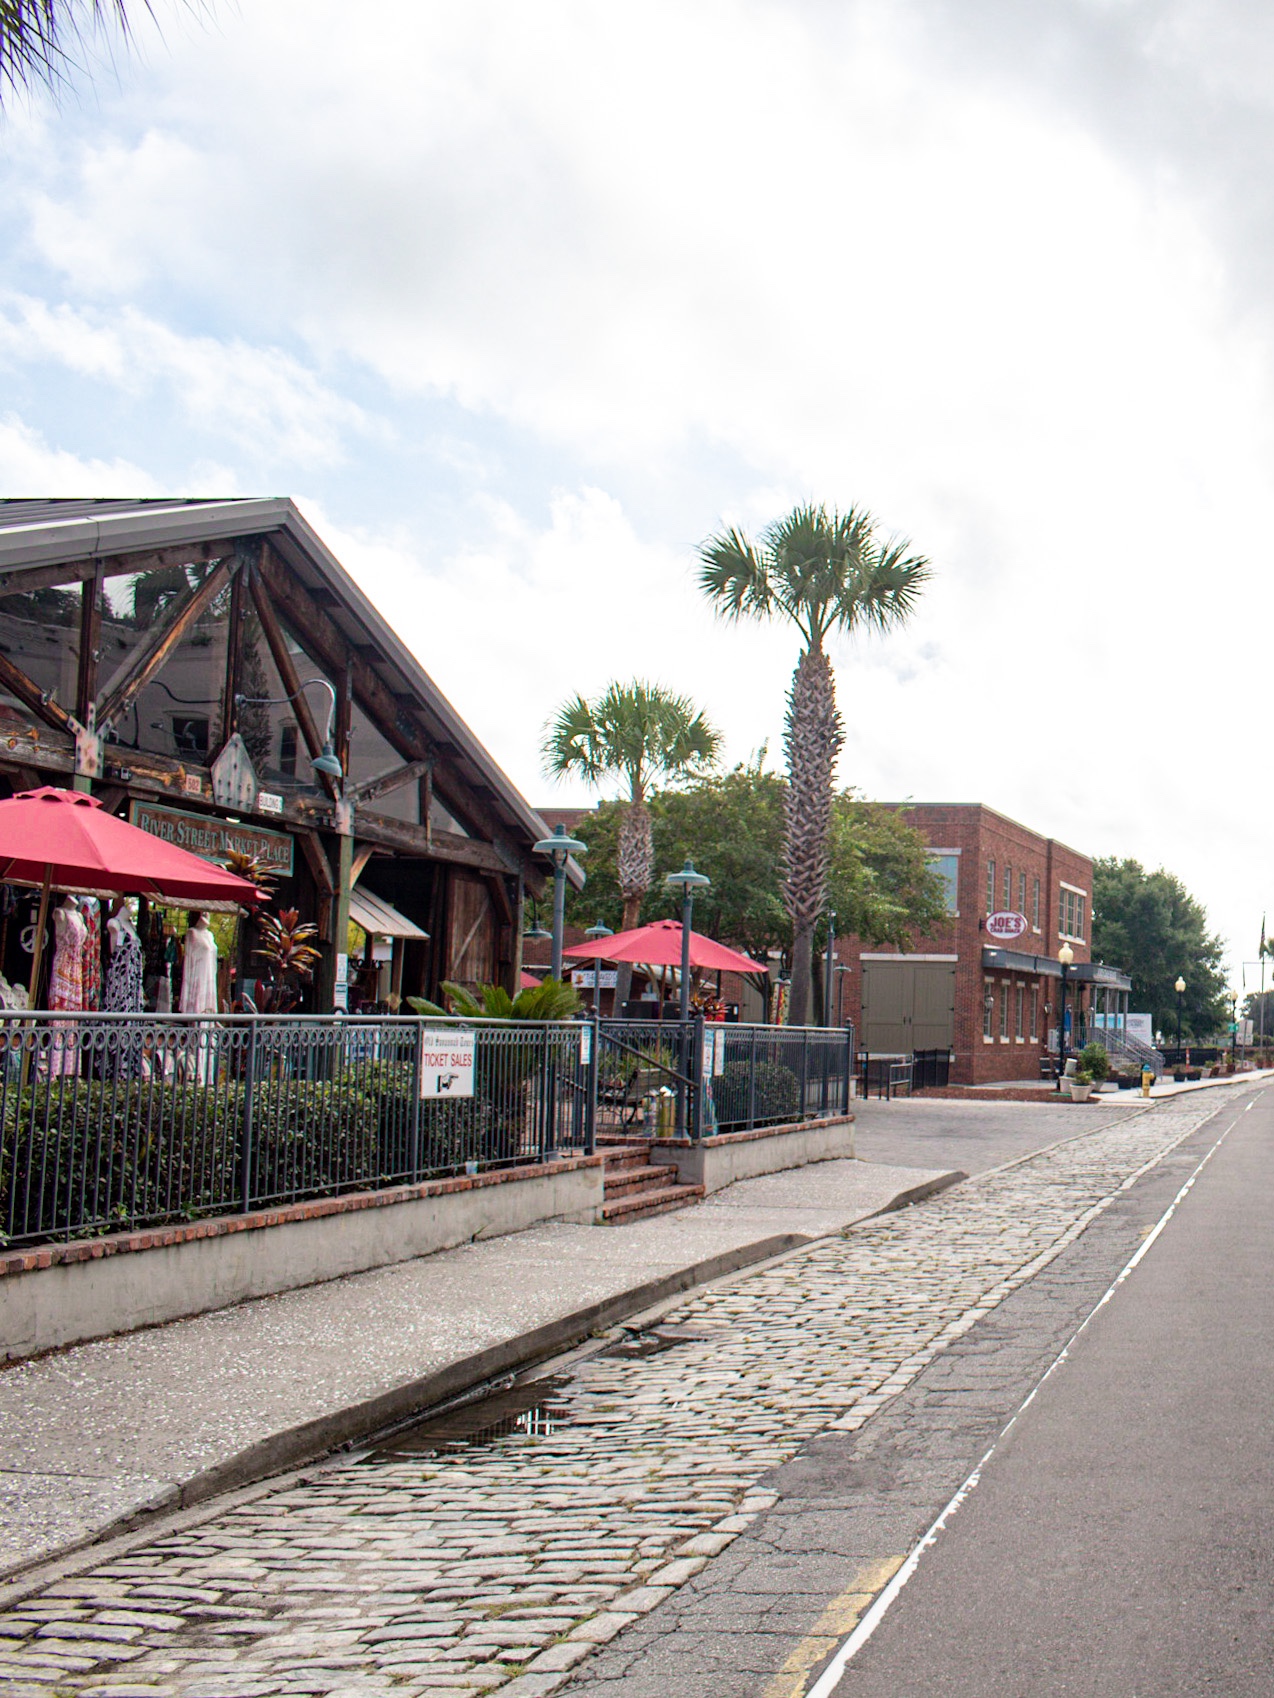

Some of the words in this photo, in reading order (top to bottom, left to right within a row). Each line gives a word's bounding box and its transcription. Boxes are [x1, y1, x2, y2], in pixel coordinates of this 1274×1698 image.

[141, 814, 174, 842] RIVER
[177, 821, 217, 850] STREET
[261, 840, 288, 863] PLACE
[990, 916, 1022, 929] JOE'S
[424, 1053, 449, 1067] TICKET
[450, 1053, 473, 1067] SALES
